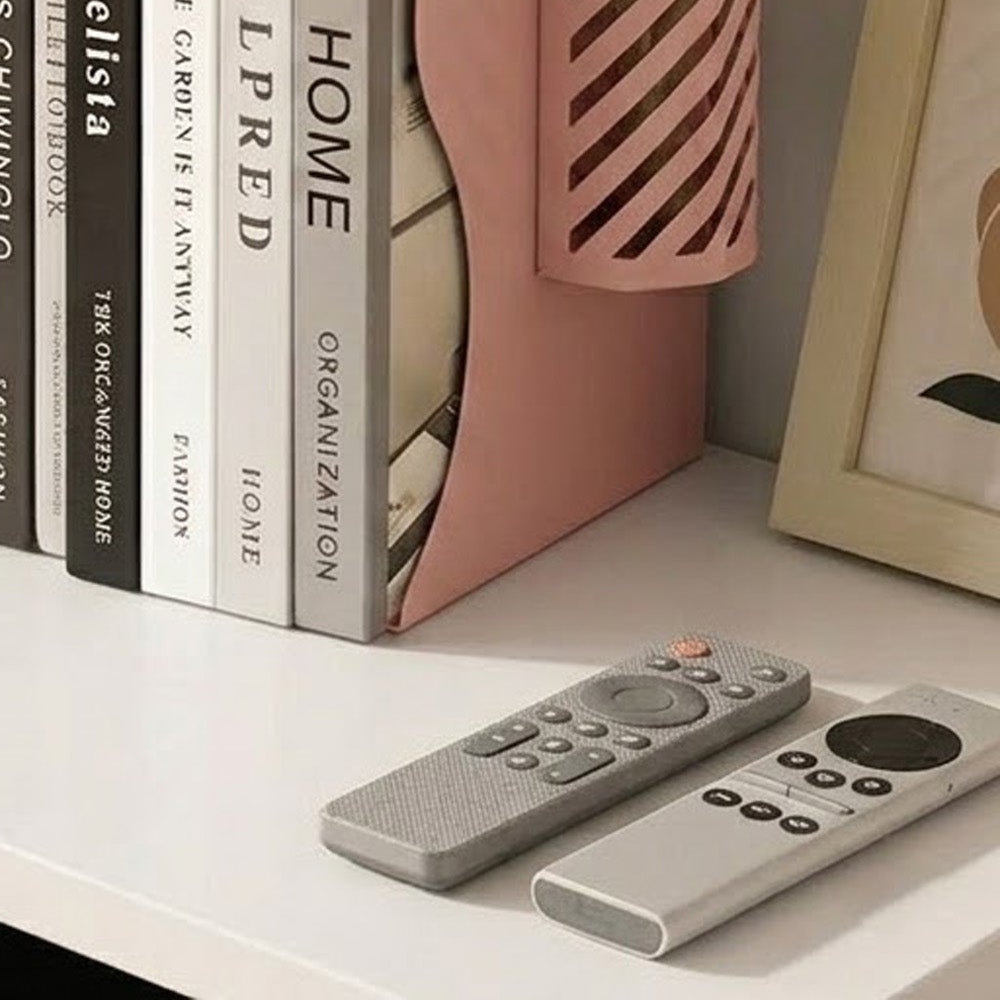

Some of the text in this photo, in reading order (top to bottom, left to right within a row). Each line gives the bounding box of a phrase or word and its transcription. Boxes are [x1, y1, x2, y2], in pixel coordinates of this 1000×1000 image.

[174, 186, 194, 212] IT
[307, 24, 352, 234] HOME
[240, 467, 261, 566] HOME
[316, 330, 340, 582] ORGANIZATION
